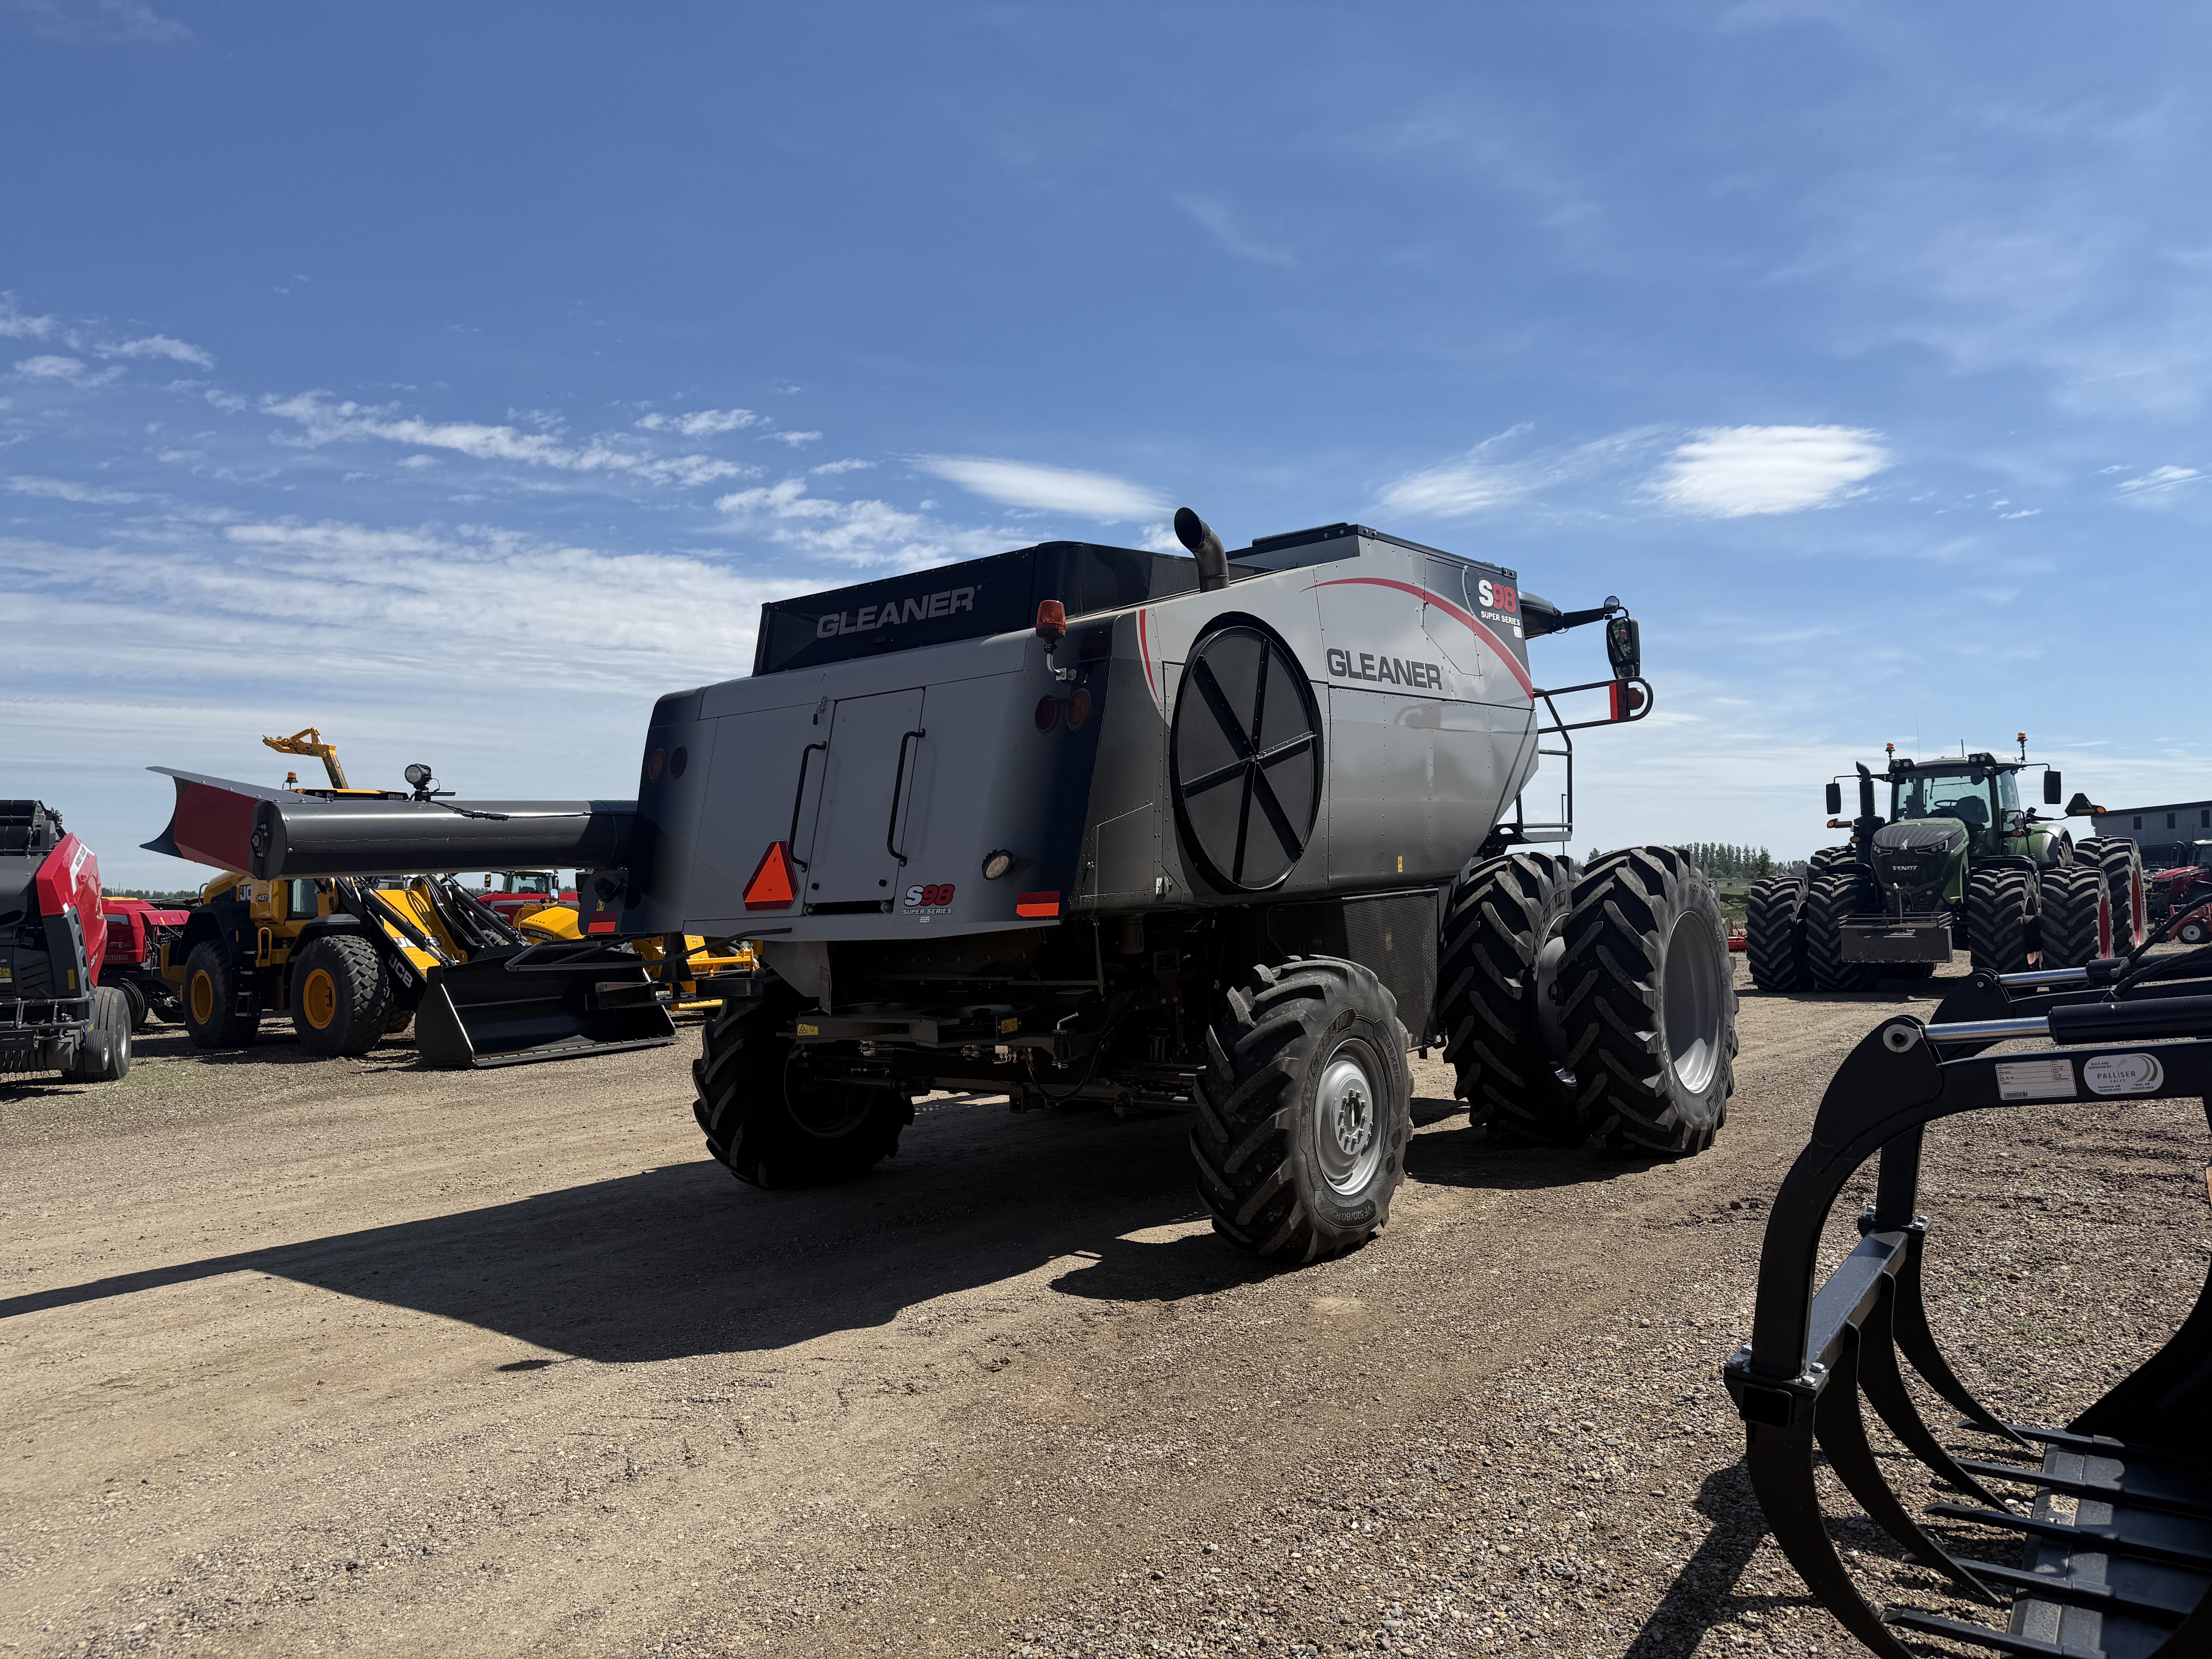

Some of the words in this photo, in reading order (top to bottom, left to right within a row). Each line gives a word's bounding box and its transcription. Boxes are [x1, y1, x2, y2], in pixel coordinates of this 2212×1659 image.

[1478, 579, 1517, 614] S98
[816, 587, 974, 638] GLEANER
[1480, 610, 1500, 622] SUPER
[1501, 615, 1520, 626] SERIES
[1327, 648, 1443, 690] GLEANER
[904, 884, 955, 907] S98
[388, 957, 413, 988] JCB
[2097, 1071, 2136, 1079] PALLISER
[1341, 1210, 1364, 1221] 520/80
